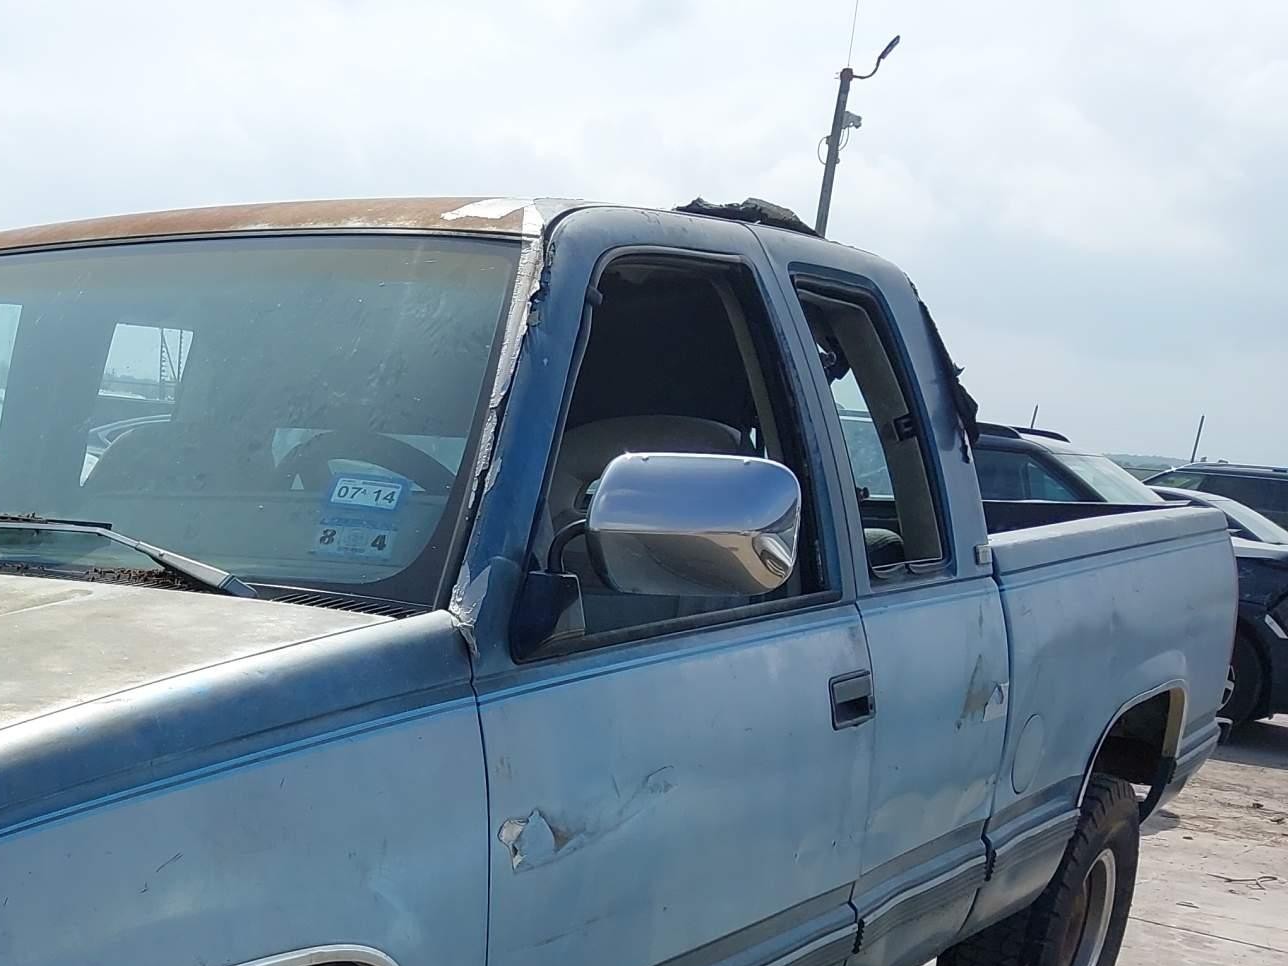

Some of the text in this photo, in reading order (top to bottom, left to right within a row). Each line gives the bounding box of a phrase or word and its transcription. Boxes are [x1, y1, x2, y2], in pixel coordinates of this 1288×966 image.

[337, 485, 362, 499] 07
[373, 489, 397, 504] 14
[319, 528, 337, 545] 8
